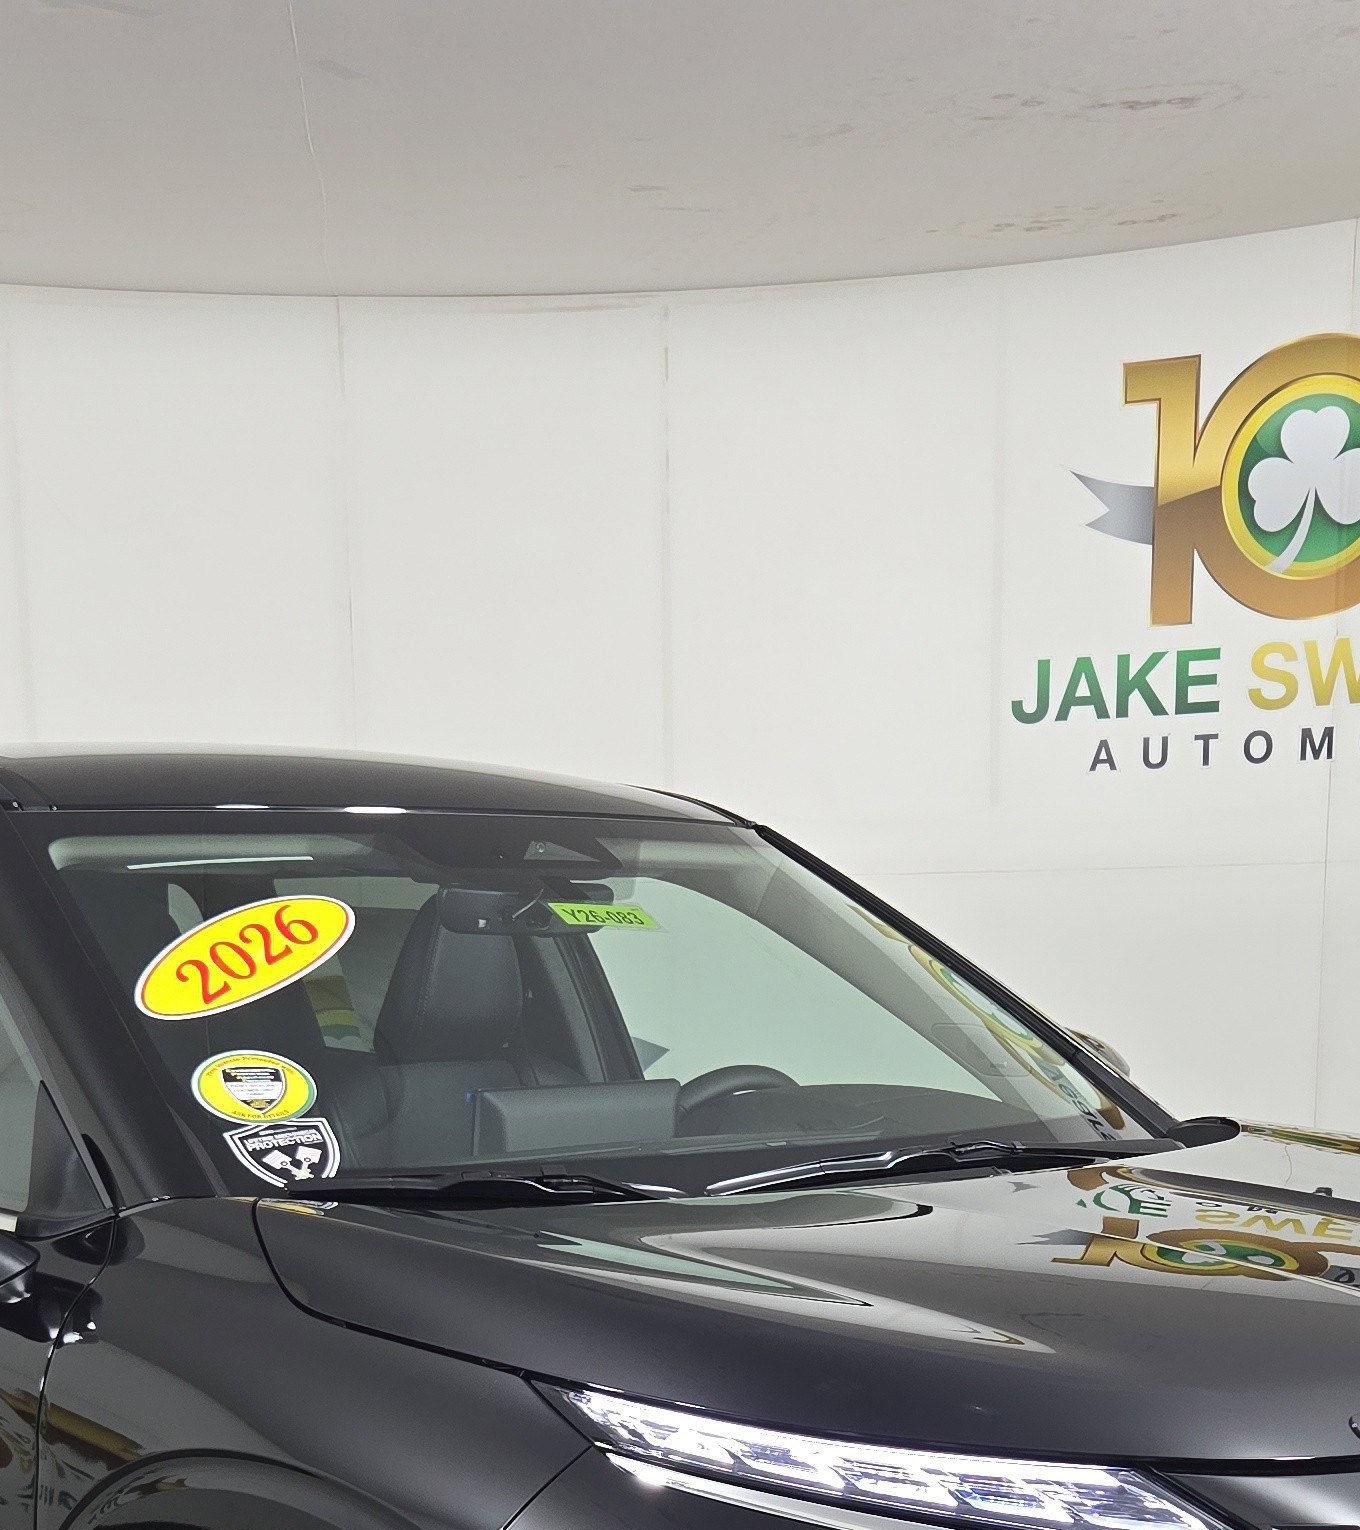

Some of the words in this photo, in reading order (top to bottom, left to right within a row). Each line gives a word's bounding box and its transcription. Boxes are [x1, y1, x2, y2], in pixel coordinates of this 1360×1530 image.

[1012, 646, 1222, 724] JAKE
[175, 904, 320, 1005] 2026
[561, 908, 645, 925] Y26-083
